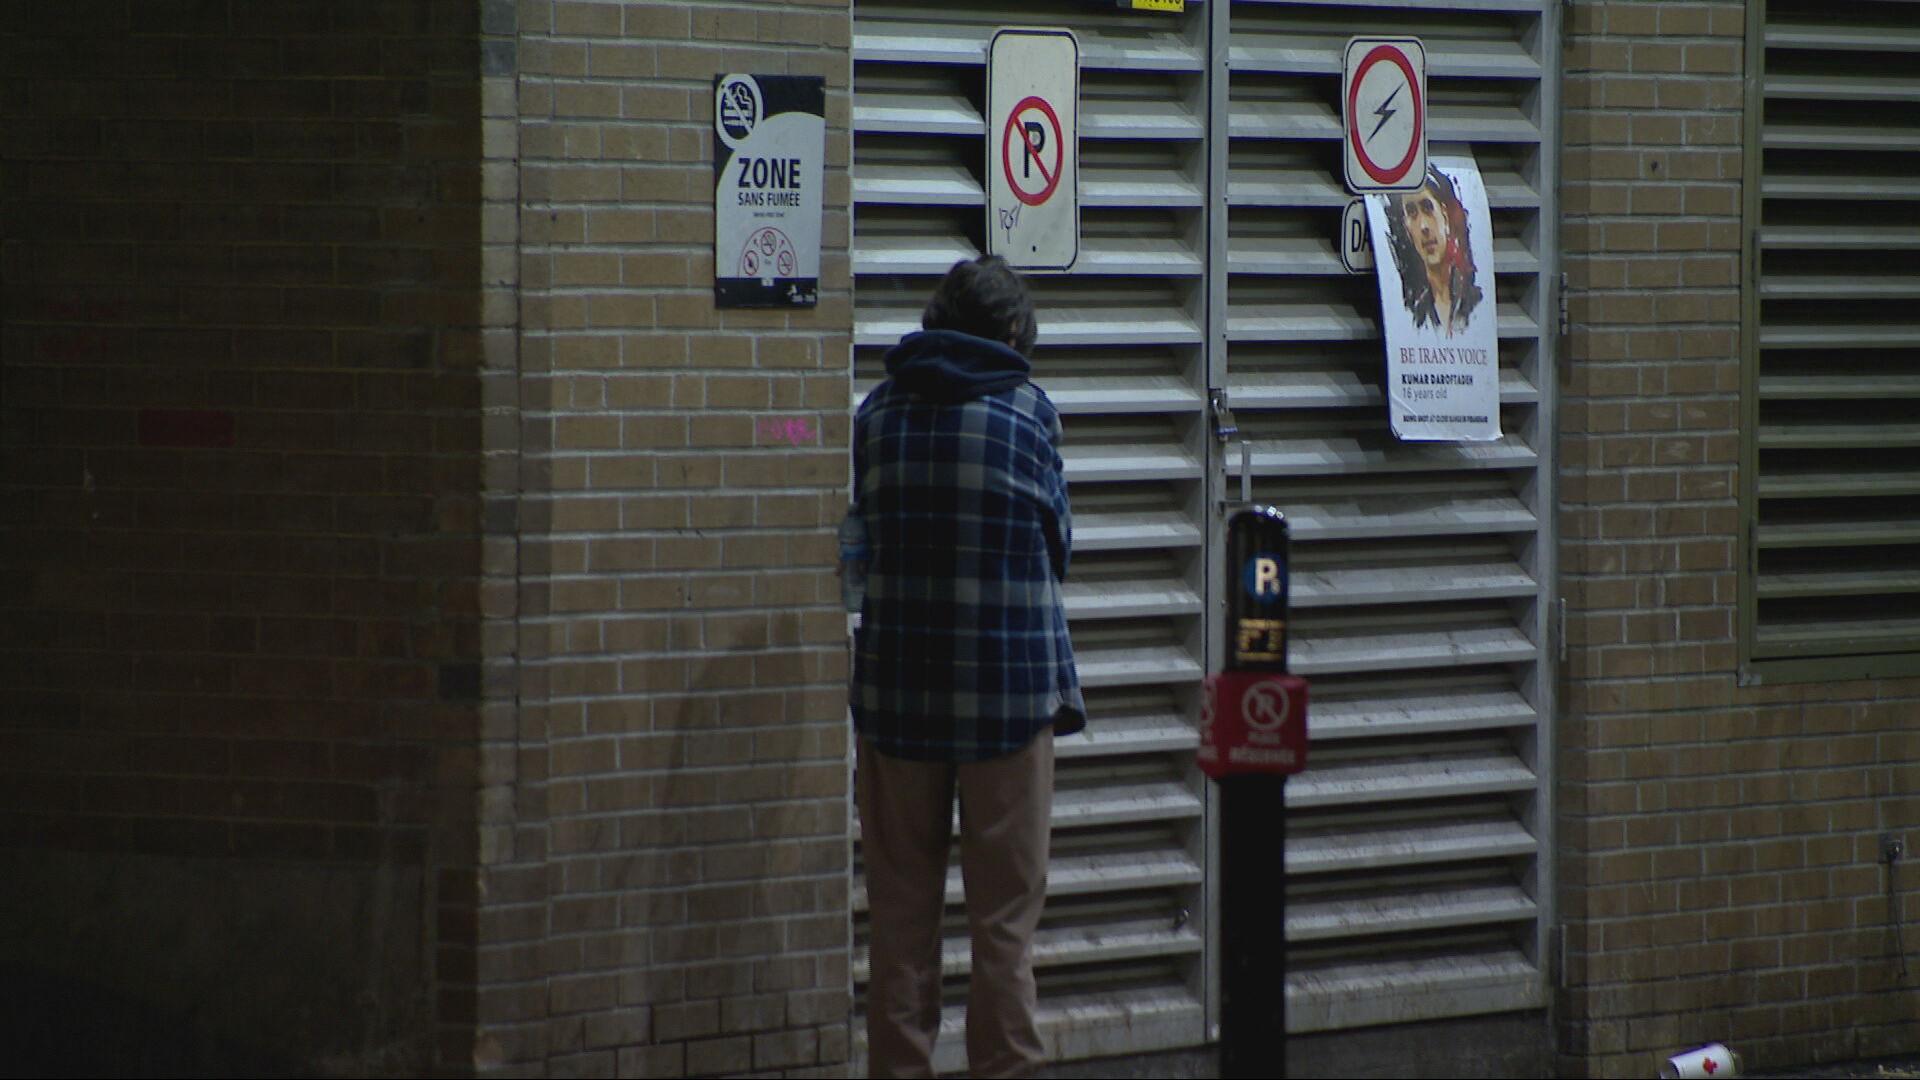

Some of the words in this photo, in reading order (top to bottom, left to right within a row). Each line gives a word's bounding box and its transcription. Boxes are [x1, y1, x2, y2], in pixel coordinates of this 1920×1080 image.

[738, 158, 801, 189] ZONE
[738, 192, 764, 206] SANS
[767, 191, 800, 207] FUMÉE
[1400, 347, 1416, 364] BE
[1418, 347, 1455, 364] IRAN'S
[1457, 348, 1488, 366] VOICE
[1401, 374, 1429, 385] KUMAR
[1402, 387, 1412, 399] 16
[1413, 389, 1434, 402] years
[1435, 387, 1447, 399] old
